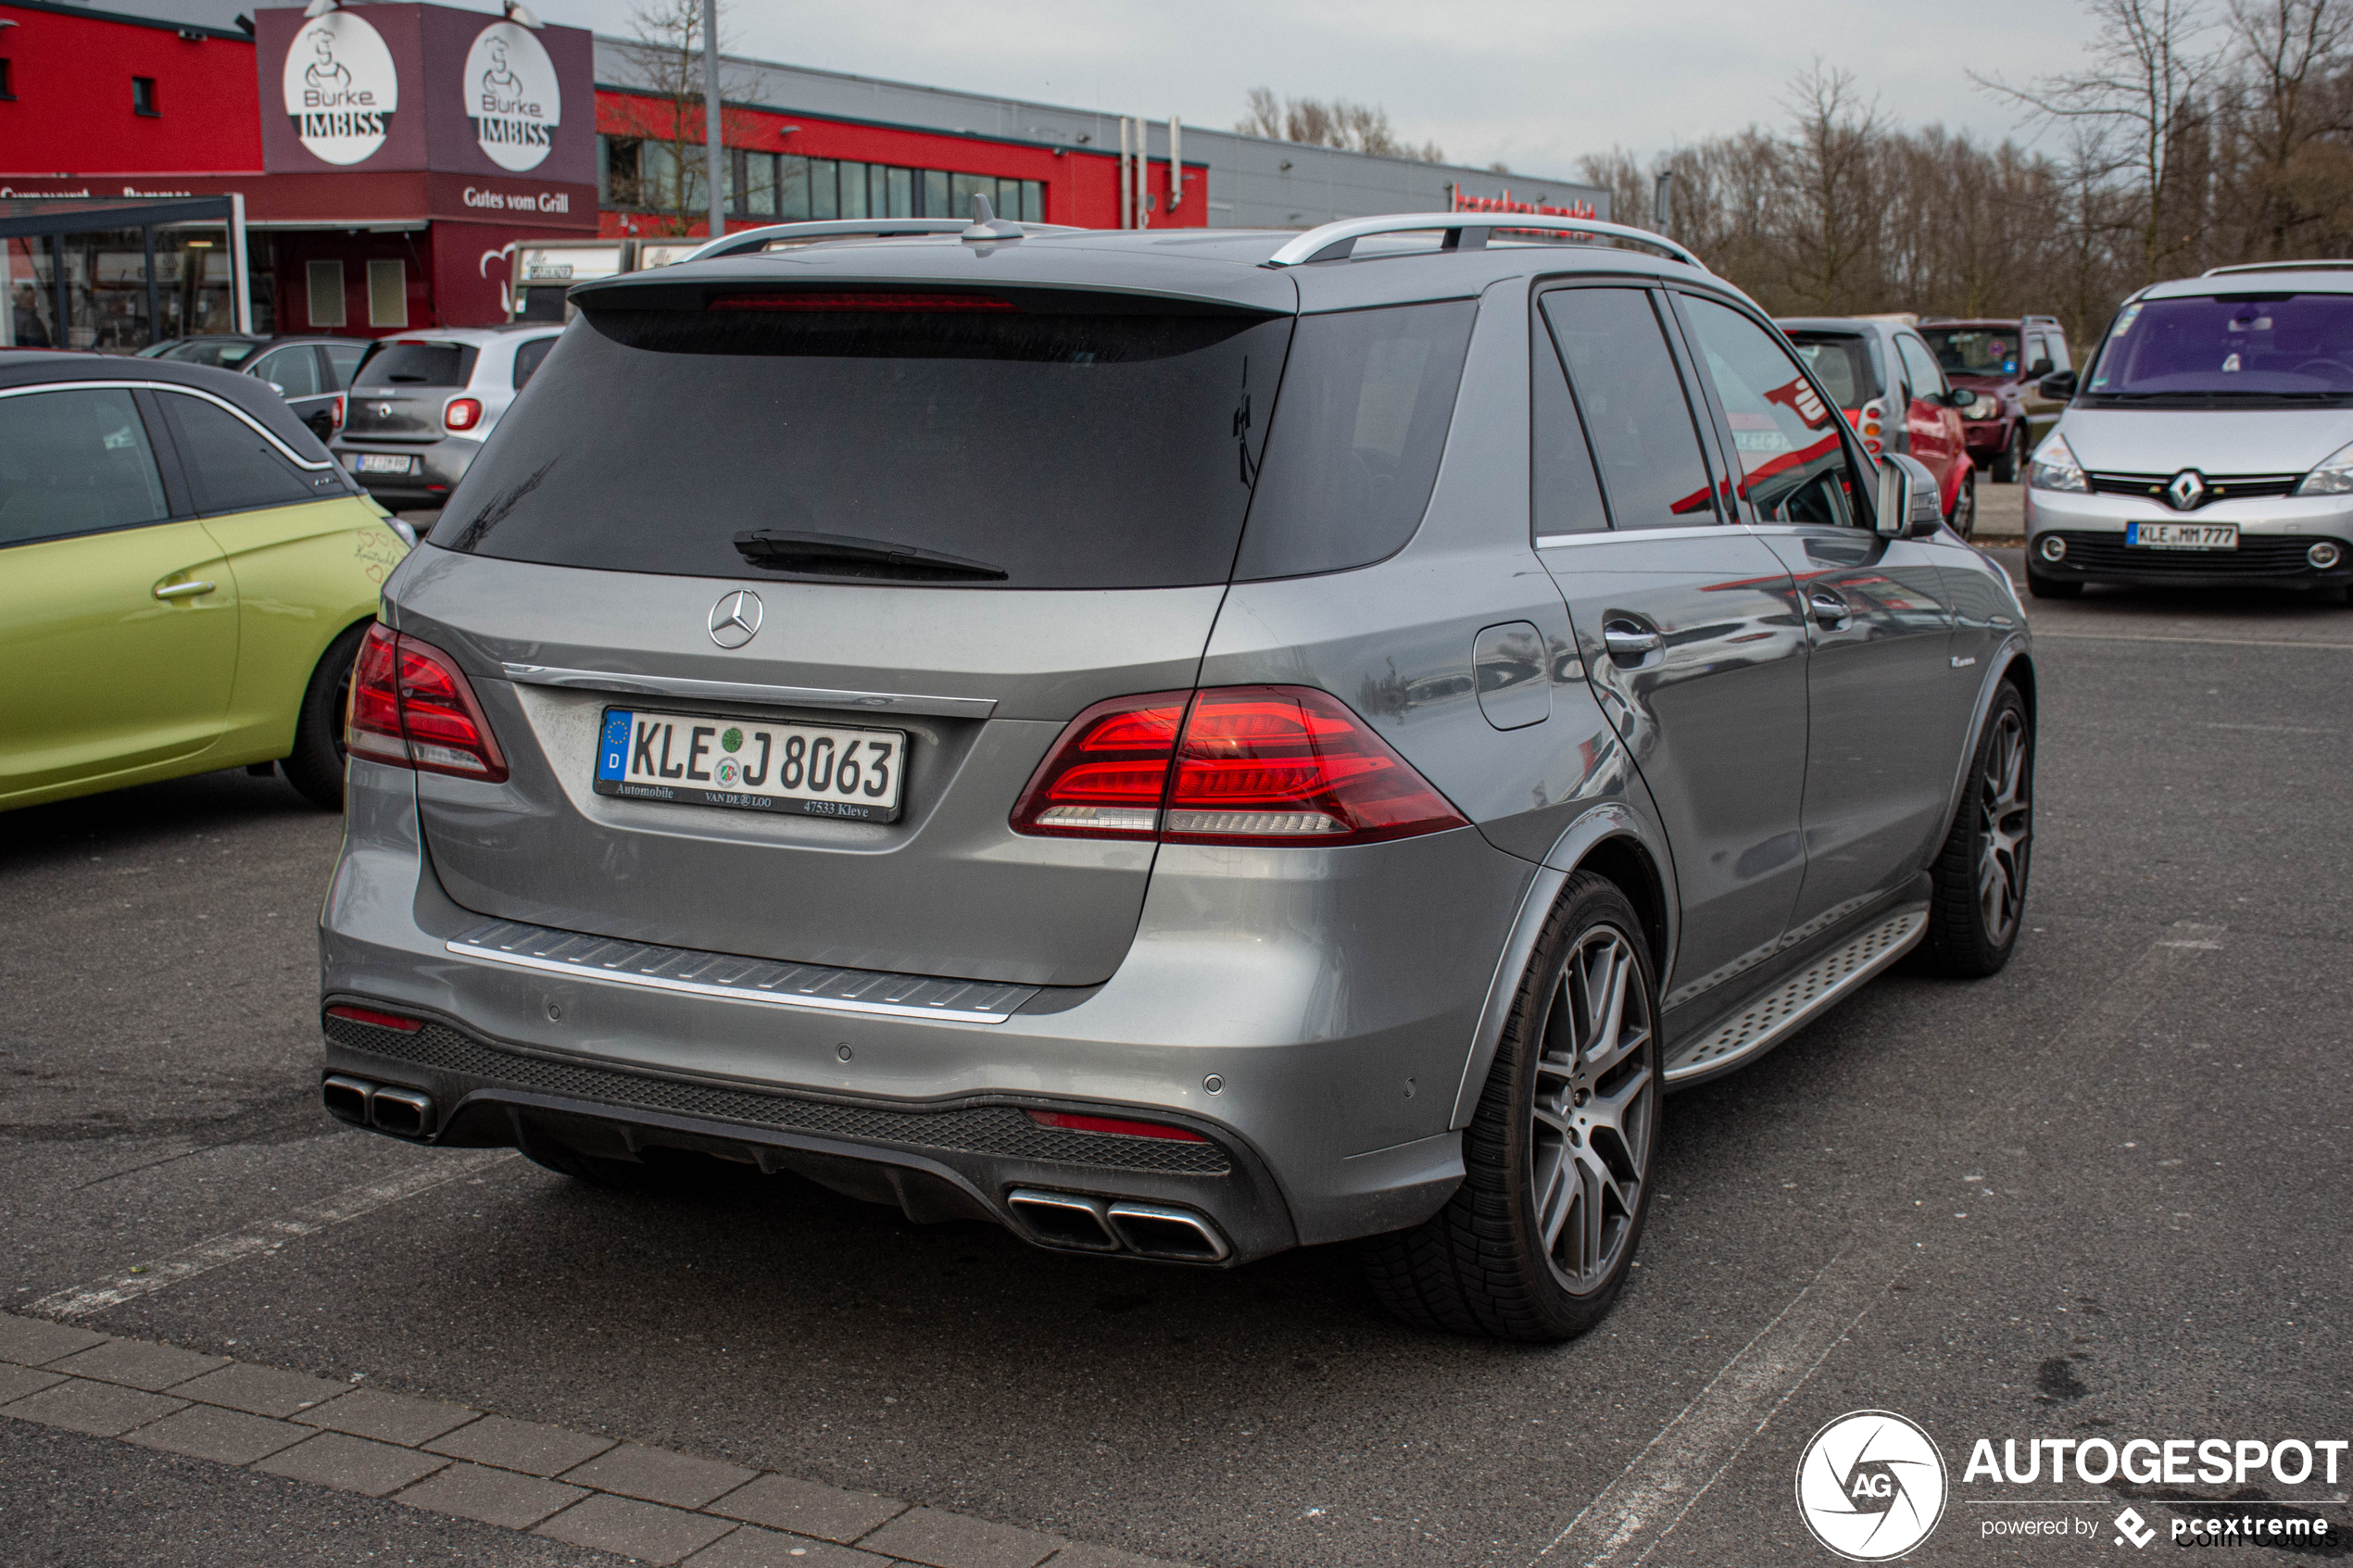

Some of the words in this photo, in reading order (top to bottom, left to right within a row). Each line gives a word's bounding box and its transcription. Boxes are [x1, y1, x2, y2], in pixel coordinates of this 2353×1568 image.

[305, 90, 376, 107] Burke
[483, 94, 544, 119] Burke
[300, 112, 385, 138] IMBISS
[478, 118, 550, 147] IMBISS
[463, 187, 505, 209] Gutes
[506, 194, 536, 211] vom
[538, 193, 569, 214] Grill
[2138, 526, 2167, 543] KLE
[2204, 528, 2234, 545] 777
[609, 753, 620, 769] D
[632, 721, 716, 782] KLE
[743, 732, 772, 786] J
[781, 735, 893, 797] 8063
[616, 783, 674, 799] Automobile
[705, 792, 725, 804] VAN
[725, 795, 741, 806] DE
[752, 797, 772, 809] LOO
[804, 801, 835, 815] 47533
[837, 803, 869, 818] Kleve
